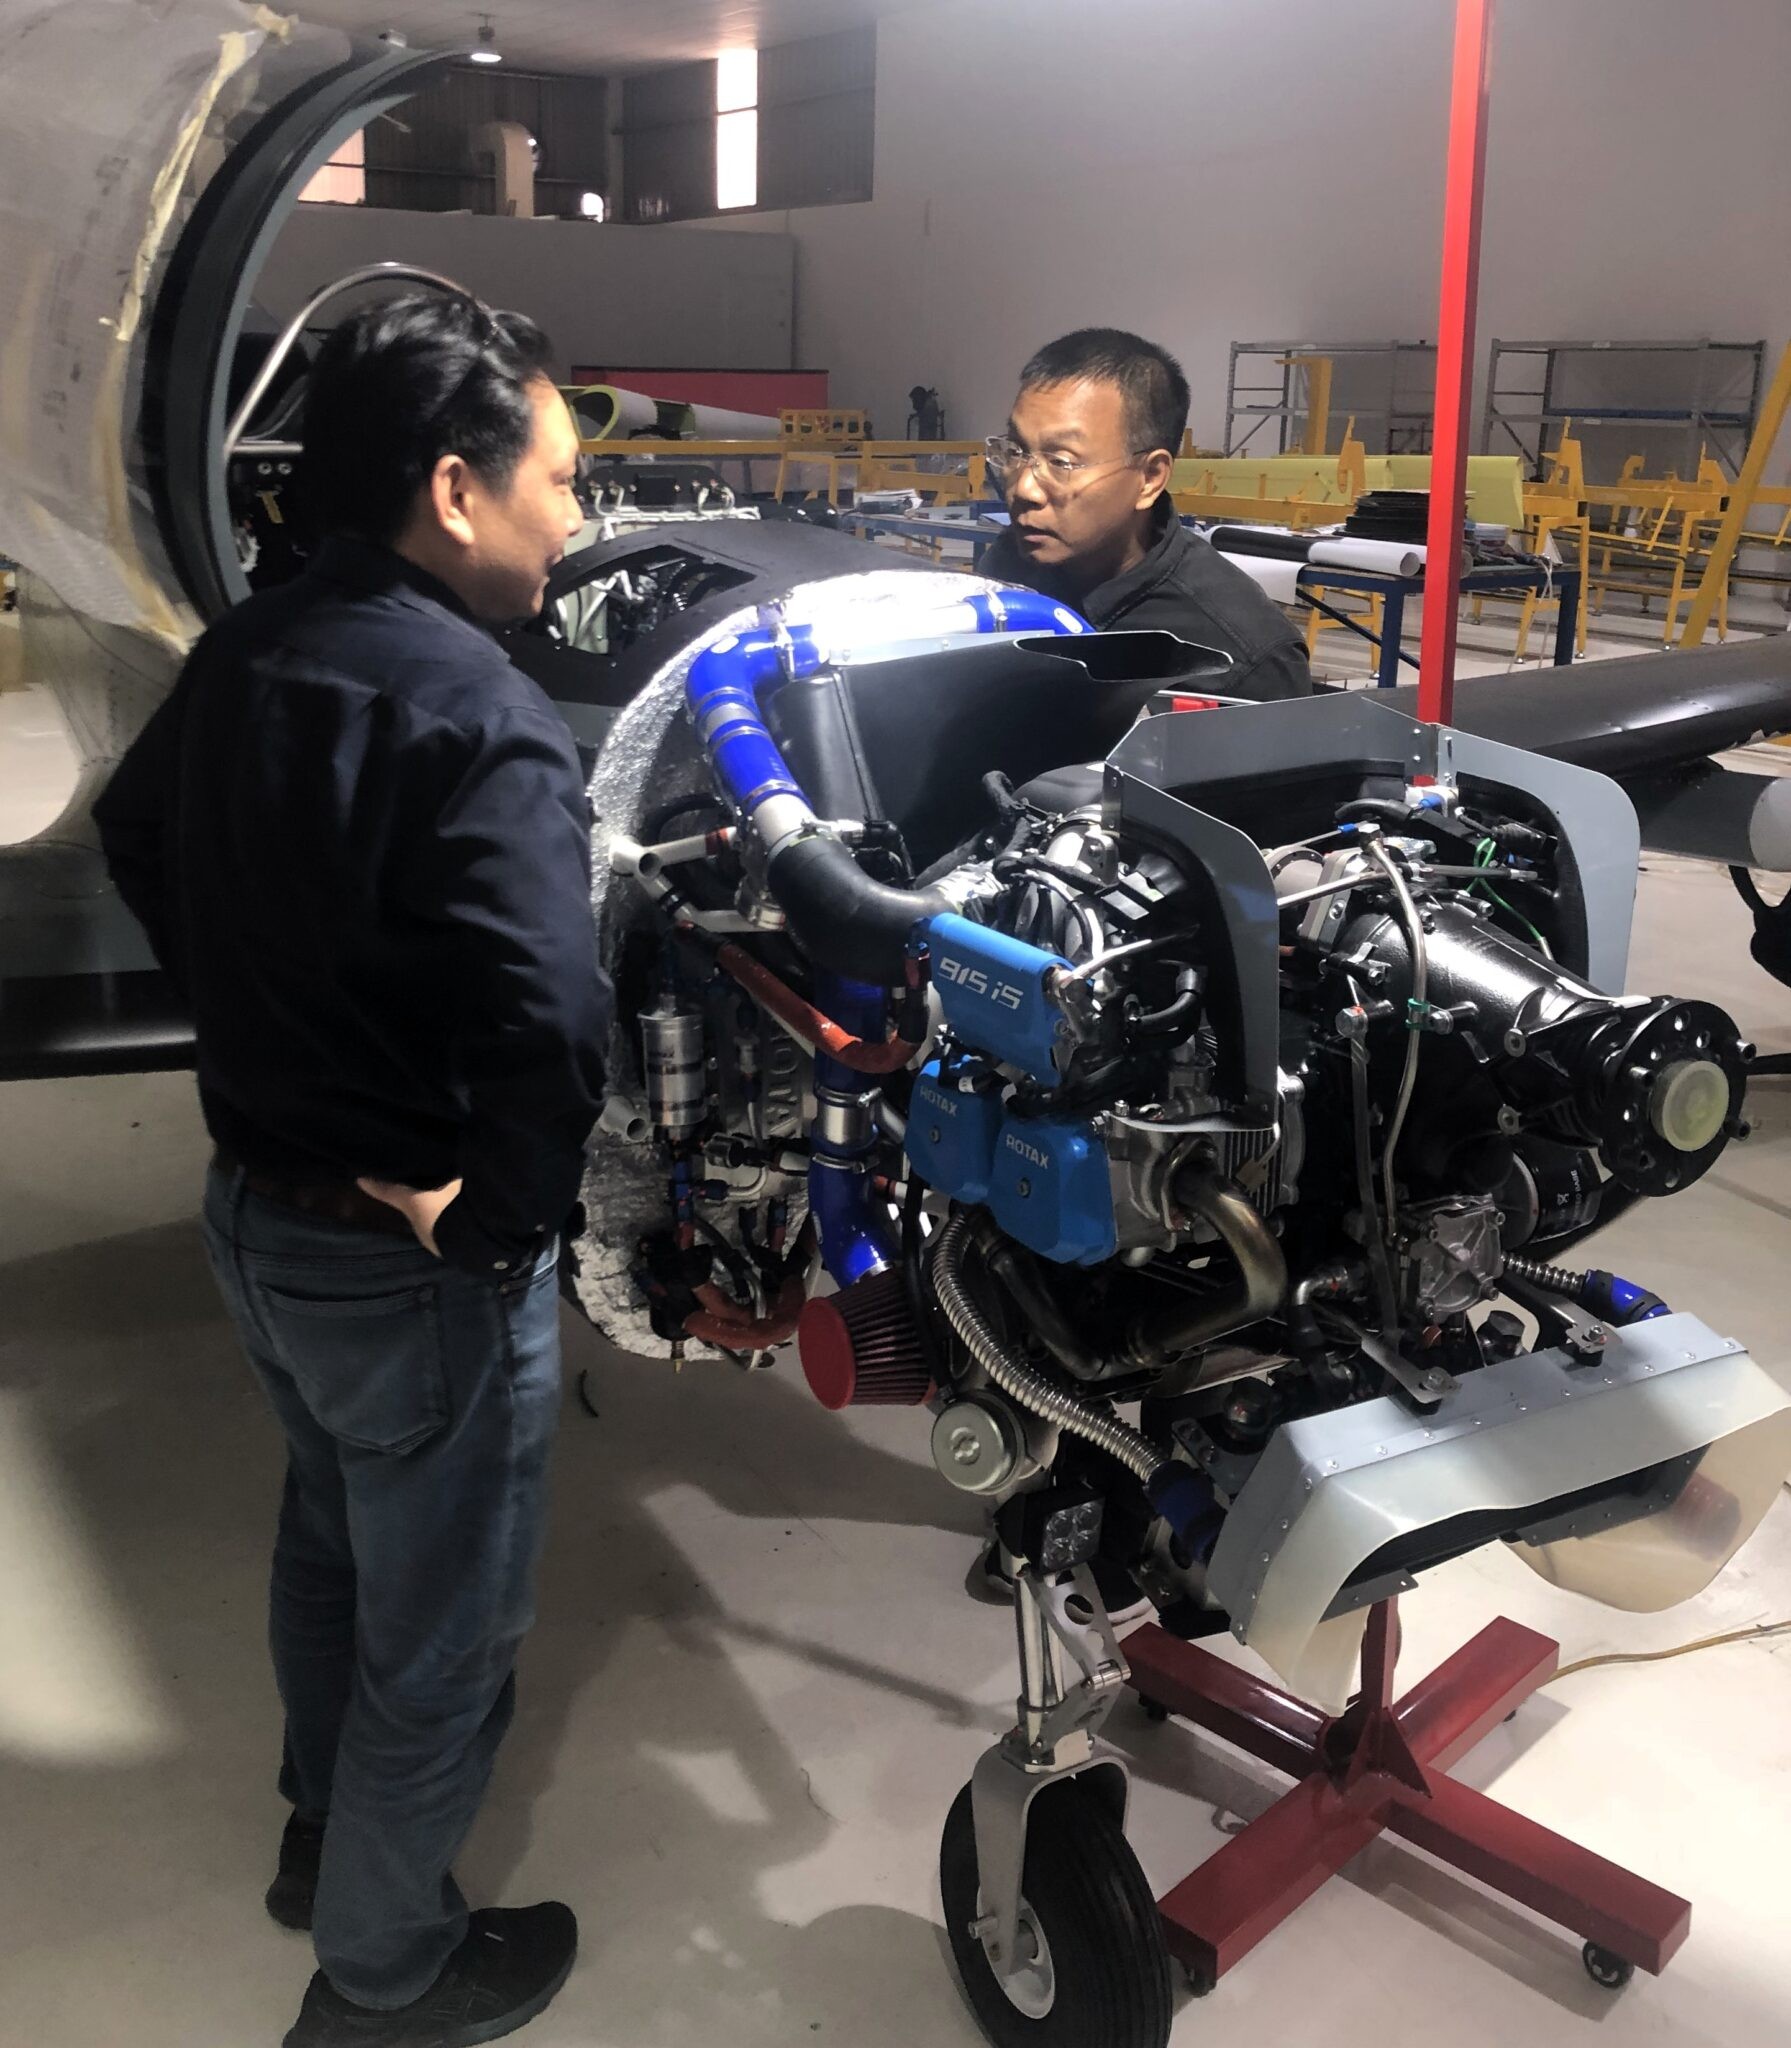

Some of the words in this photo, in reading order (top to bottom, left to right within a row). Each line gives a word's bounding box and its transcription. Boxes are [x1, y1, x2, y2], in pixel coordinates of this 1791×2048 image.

[938, 957, 988, 994] 915
[919, 1085, 958, 1117] ROTAX
[1006, 1134, 1049, 1169] ROTAX
